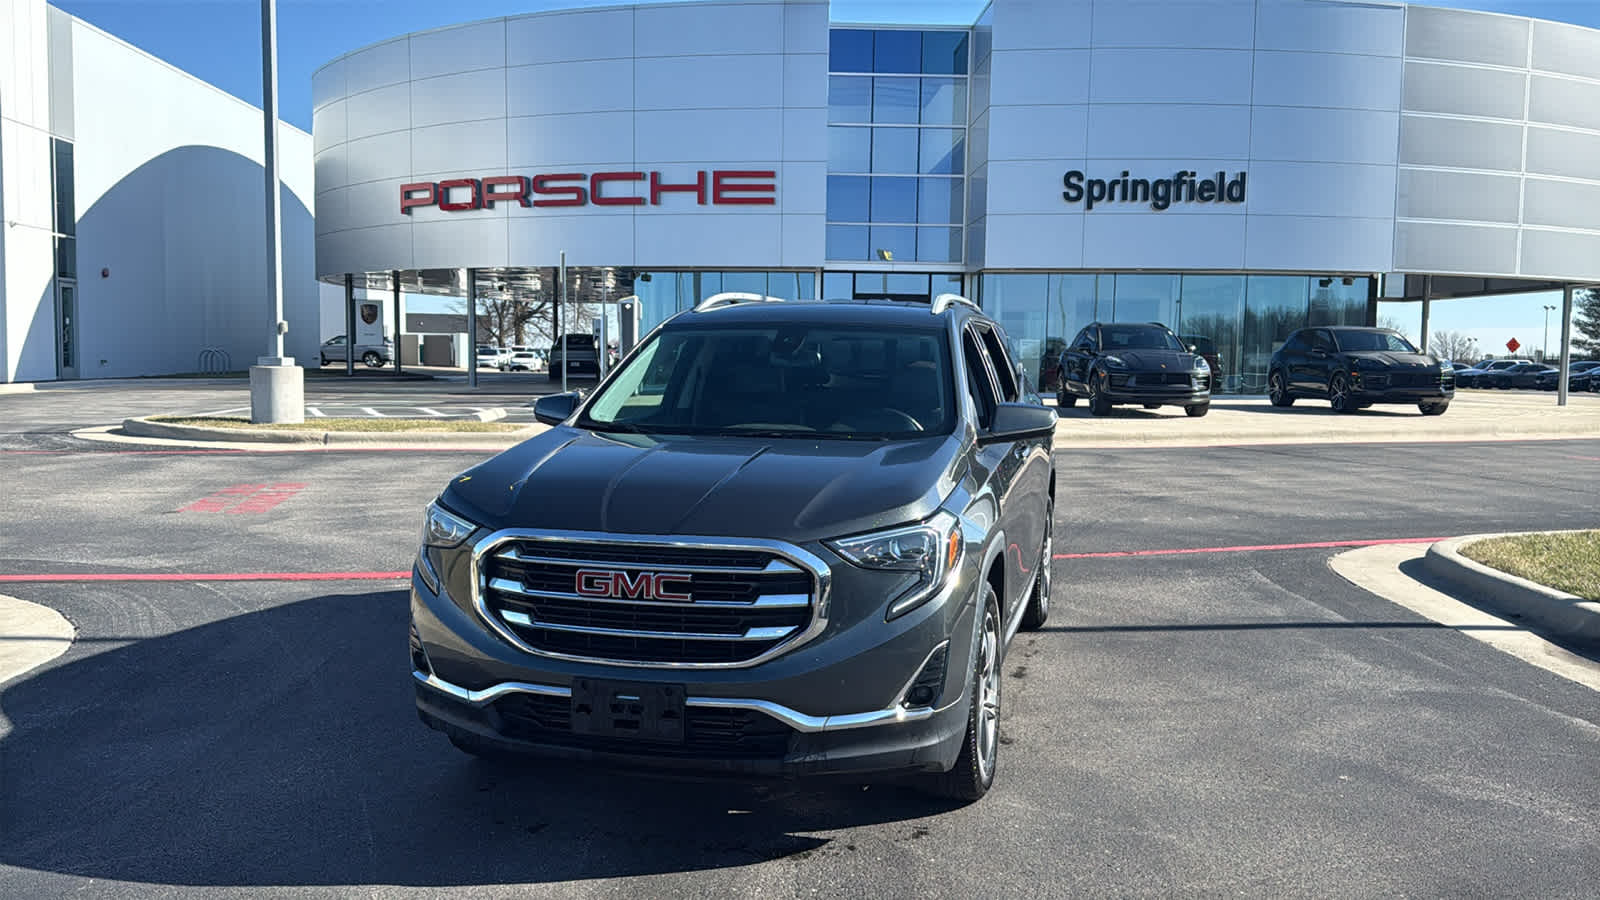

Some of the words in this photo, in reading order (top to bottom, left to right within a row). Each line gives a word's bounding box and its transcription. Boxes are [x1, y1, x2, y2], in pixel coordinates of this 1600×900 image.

[400, 170, 776, 214] PORSCHE
[1063, 170, 1247, 210] Springfield
[575, 568, 692, 601] GMC
